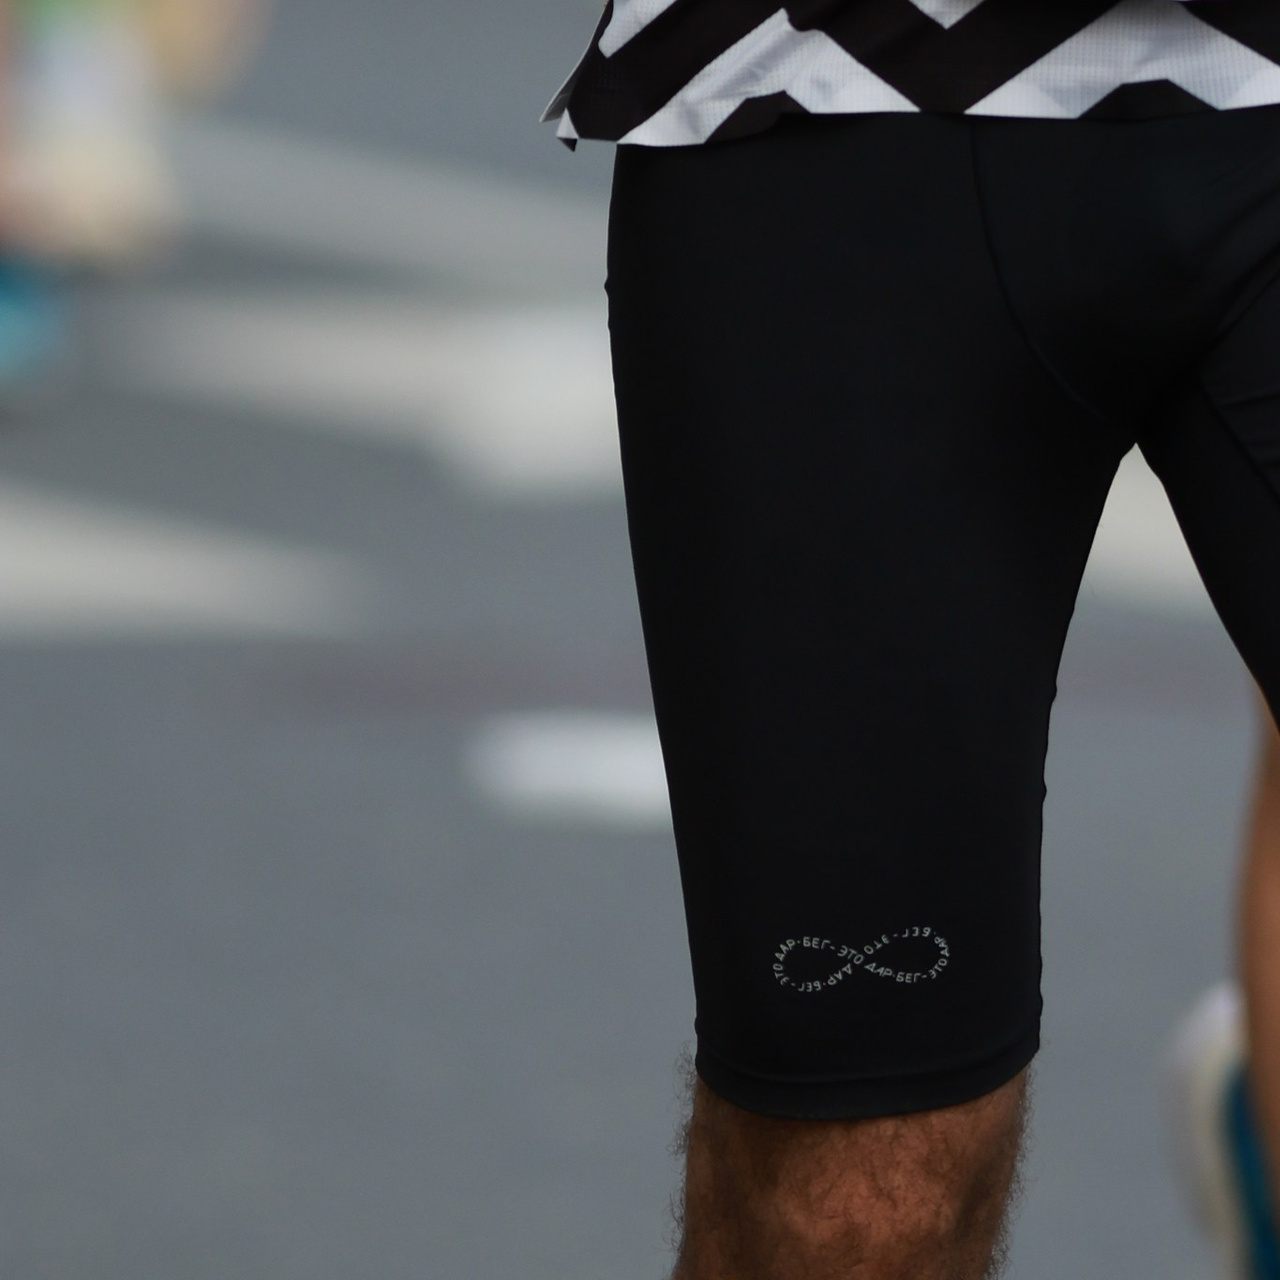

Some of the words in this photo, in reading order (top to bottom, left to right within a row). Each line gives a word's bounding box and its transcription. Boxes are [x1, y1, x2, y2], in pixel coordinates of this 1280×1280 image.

[802, 936, 830, 949] БЕГ
[837, 945, 865, 965] ЭТО
[895, 971, 921, 983] БЕГ
